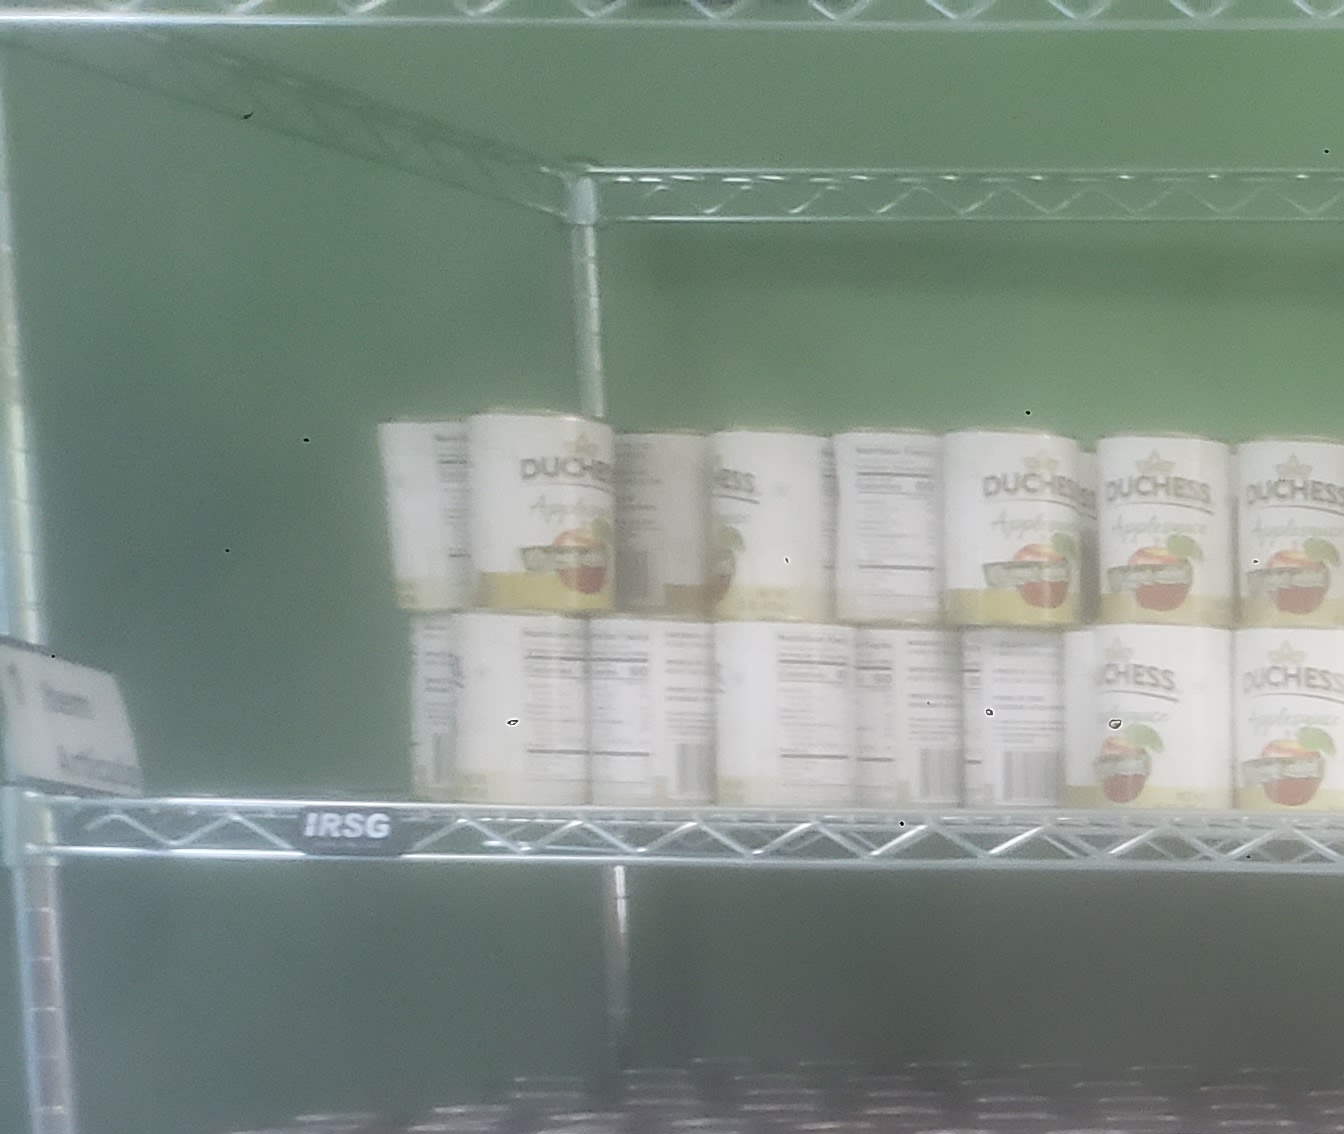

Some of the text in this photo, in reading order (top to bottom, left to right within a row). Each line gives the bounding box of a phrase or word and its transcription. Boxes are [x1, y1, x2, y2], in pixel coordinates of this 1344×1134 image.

[1103, 474, 1210, 505] DUCHESS
[1097, 662, 1175, 692] CHESS
[304, 813, 391, 839] IRSG
